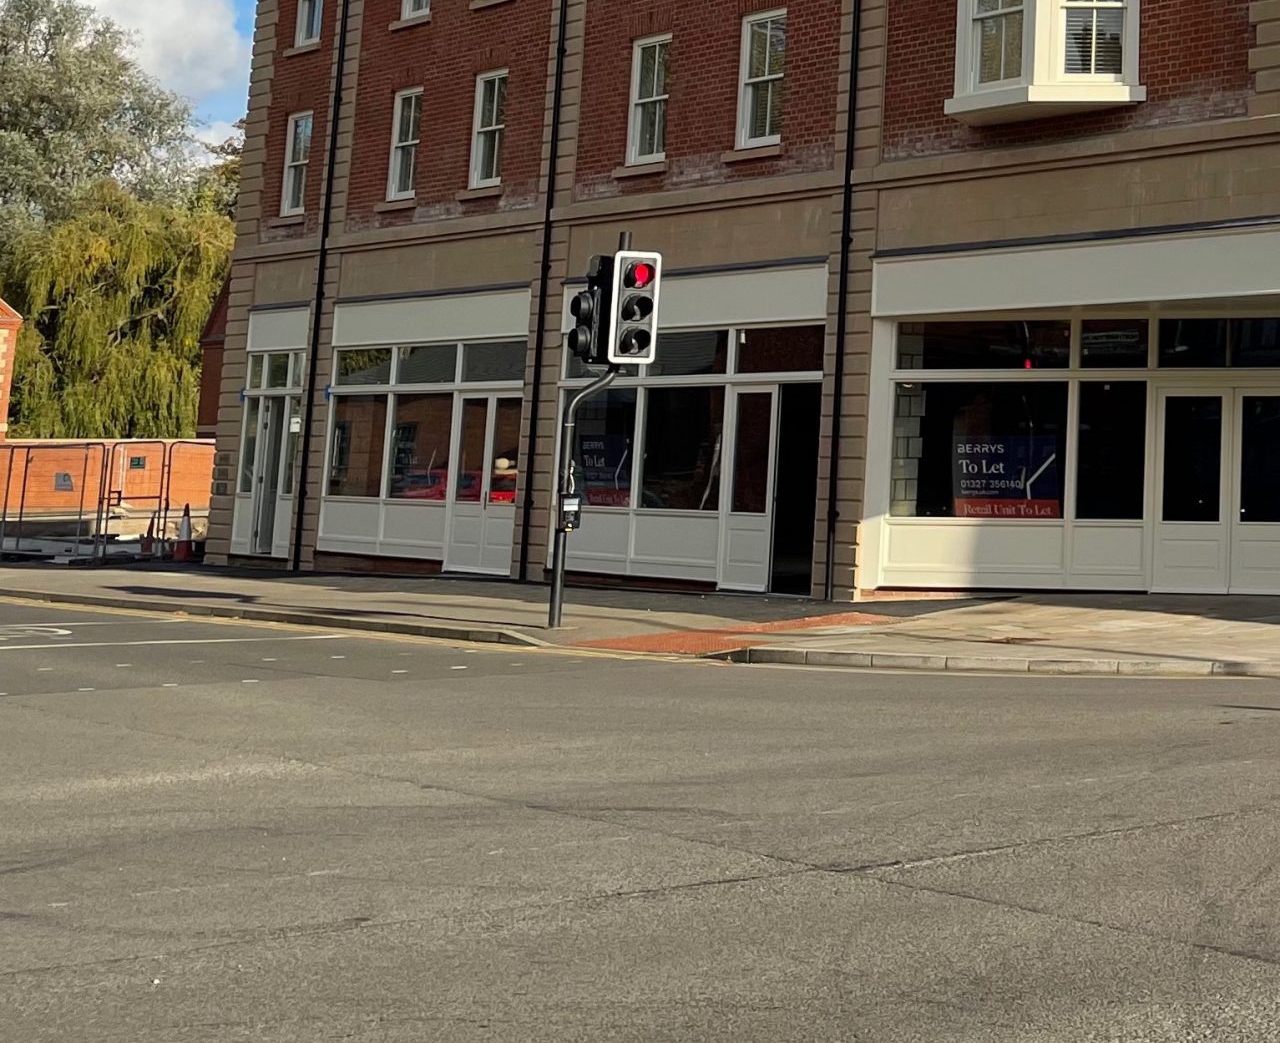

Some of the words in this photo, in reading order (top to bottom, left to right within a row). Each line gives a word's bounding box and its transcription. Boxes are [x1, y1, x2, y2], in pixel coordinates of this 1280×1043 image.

[957, 444, 1005, 454] BERRYS
[958, 459, 978, 474] To
[982, 459, 1005, 474] Let
[960, 479, 986, 489] 01327
[990, 479, 1021, 489] 356140
[963, 503, 992, 516] Retail
[994, 504, 1016, 516] Unit
[1017, 504, 1033, 516] To
[1035, 504, 1052, 516] Let
